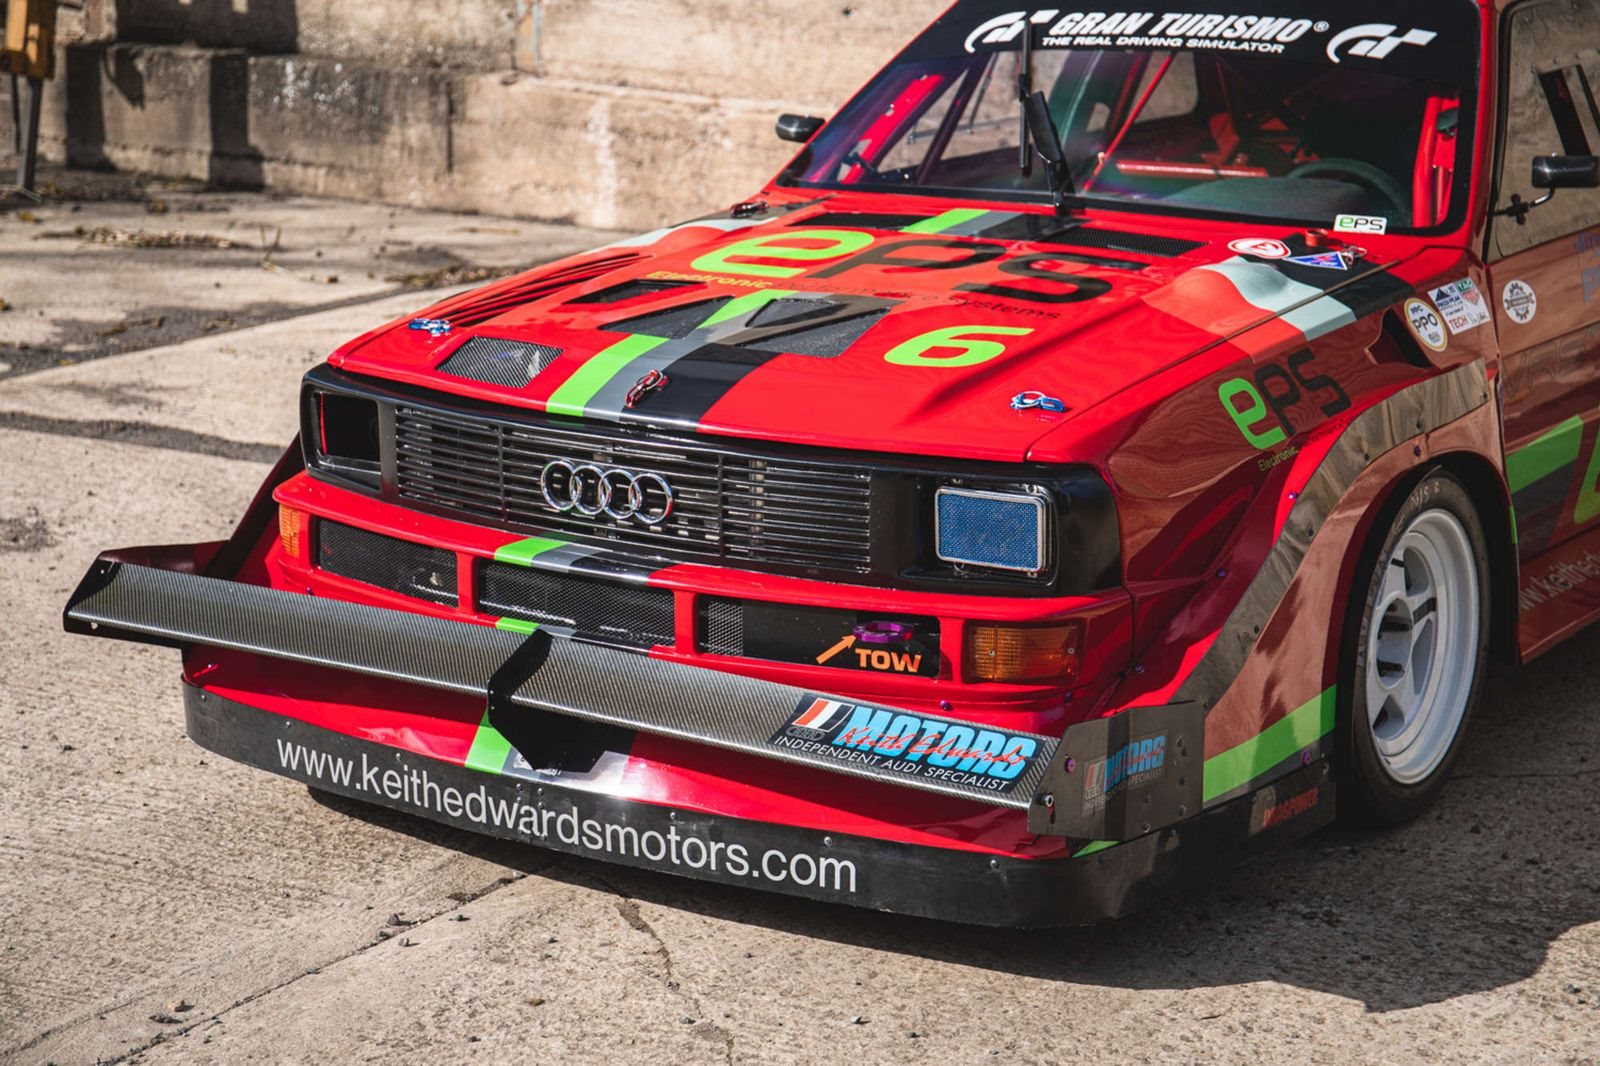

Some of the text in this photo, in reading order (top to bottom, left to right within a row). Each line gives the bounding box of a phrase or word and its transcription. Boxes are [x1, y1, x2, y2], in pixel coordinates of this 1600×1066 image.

[1049, 12, 1155, 36] GRAN
[1042, 37, 1286, 54] THE REAL DRIVING SIMULATOR
[1411, 312, 1438, 333] PPO
[884, 325, 1036, 367] 6
[855, 648, 922, 673] TOW
[832, 706, 1037, 780] MOTORS
[908, 733, 1026, 766] Edwards
[774, 736, 1010, 792] INDEPENDENT AUDI SPECIALIST
[276, 737, 858, 894] www.keithedwardsmotors.com
